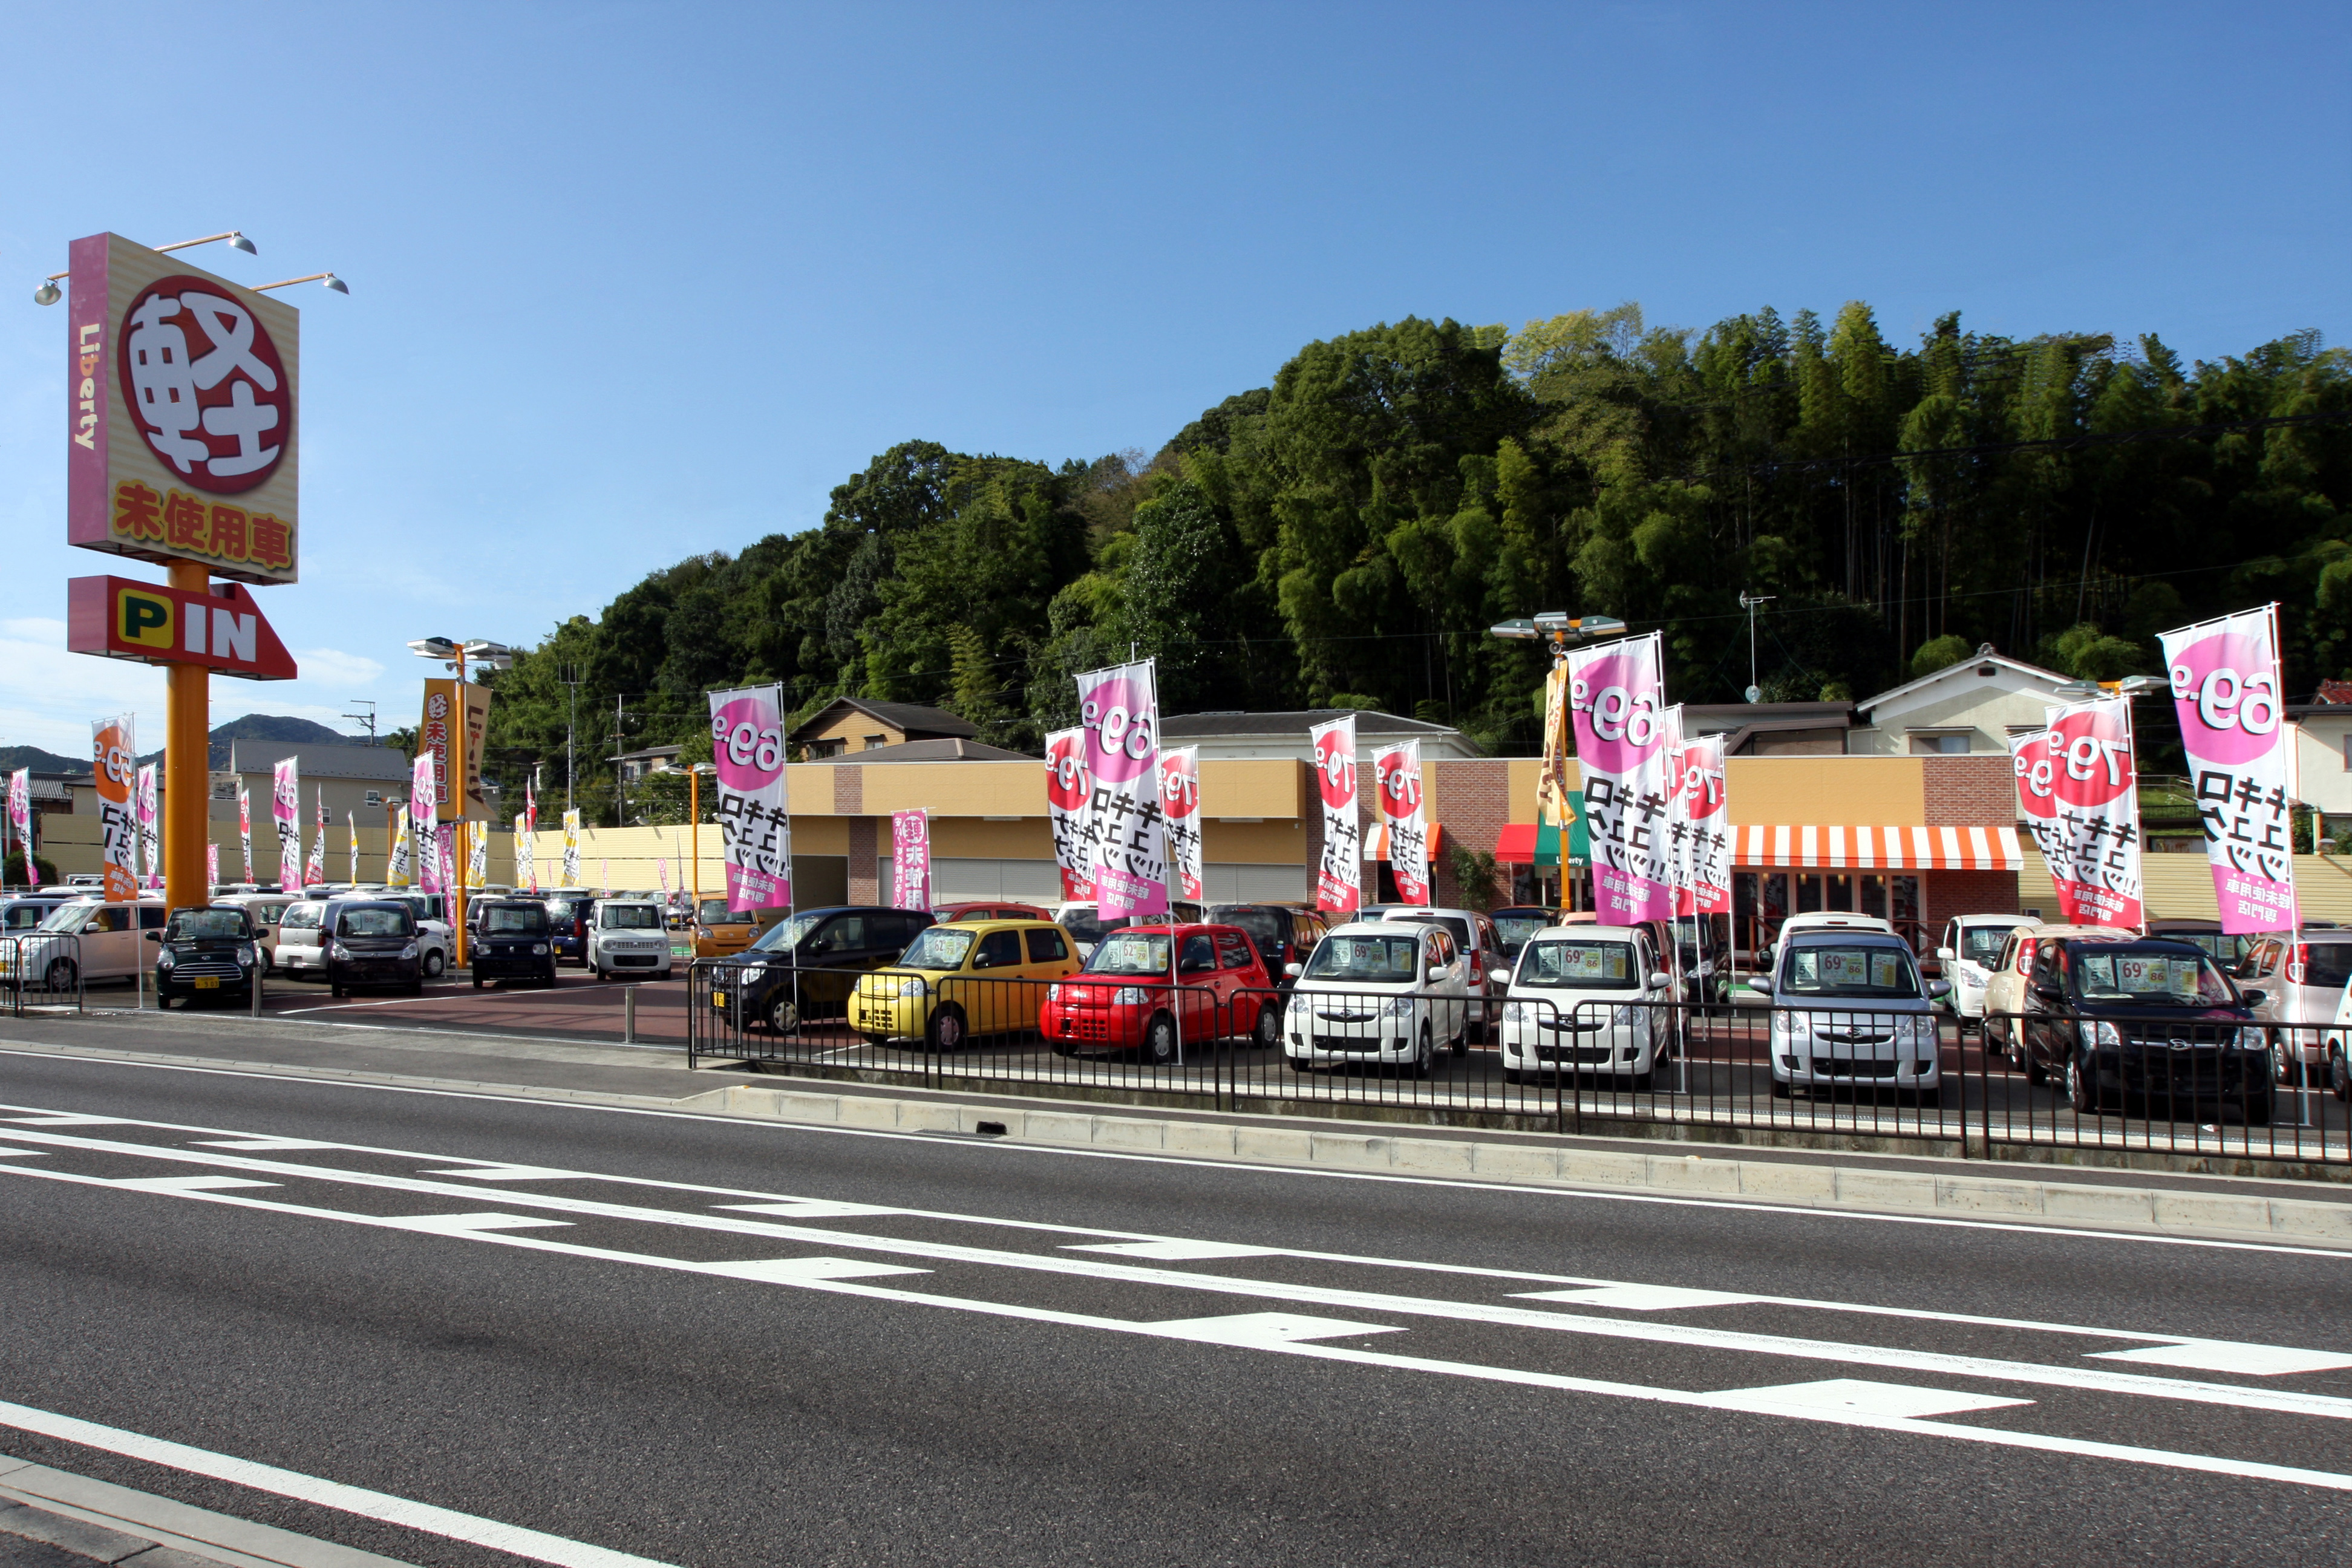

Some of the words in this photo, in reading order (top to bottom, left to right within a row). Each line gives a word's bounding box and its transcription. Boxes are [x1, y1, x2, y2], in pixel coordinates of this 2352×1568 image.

[75, 323, 100, 451] Liberty
[128, 291, 279, 476] 軽
[116, 484, 288, 567] 未使用車
[125, 596, 167, 638] P
[185, 602, 256, 662] IN
